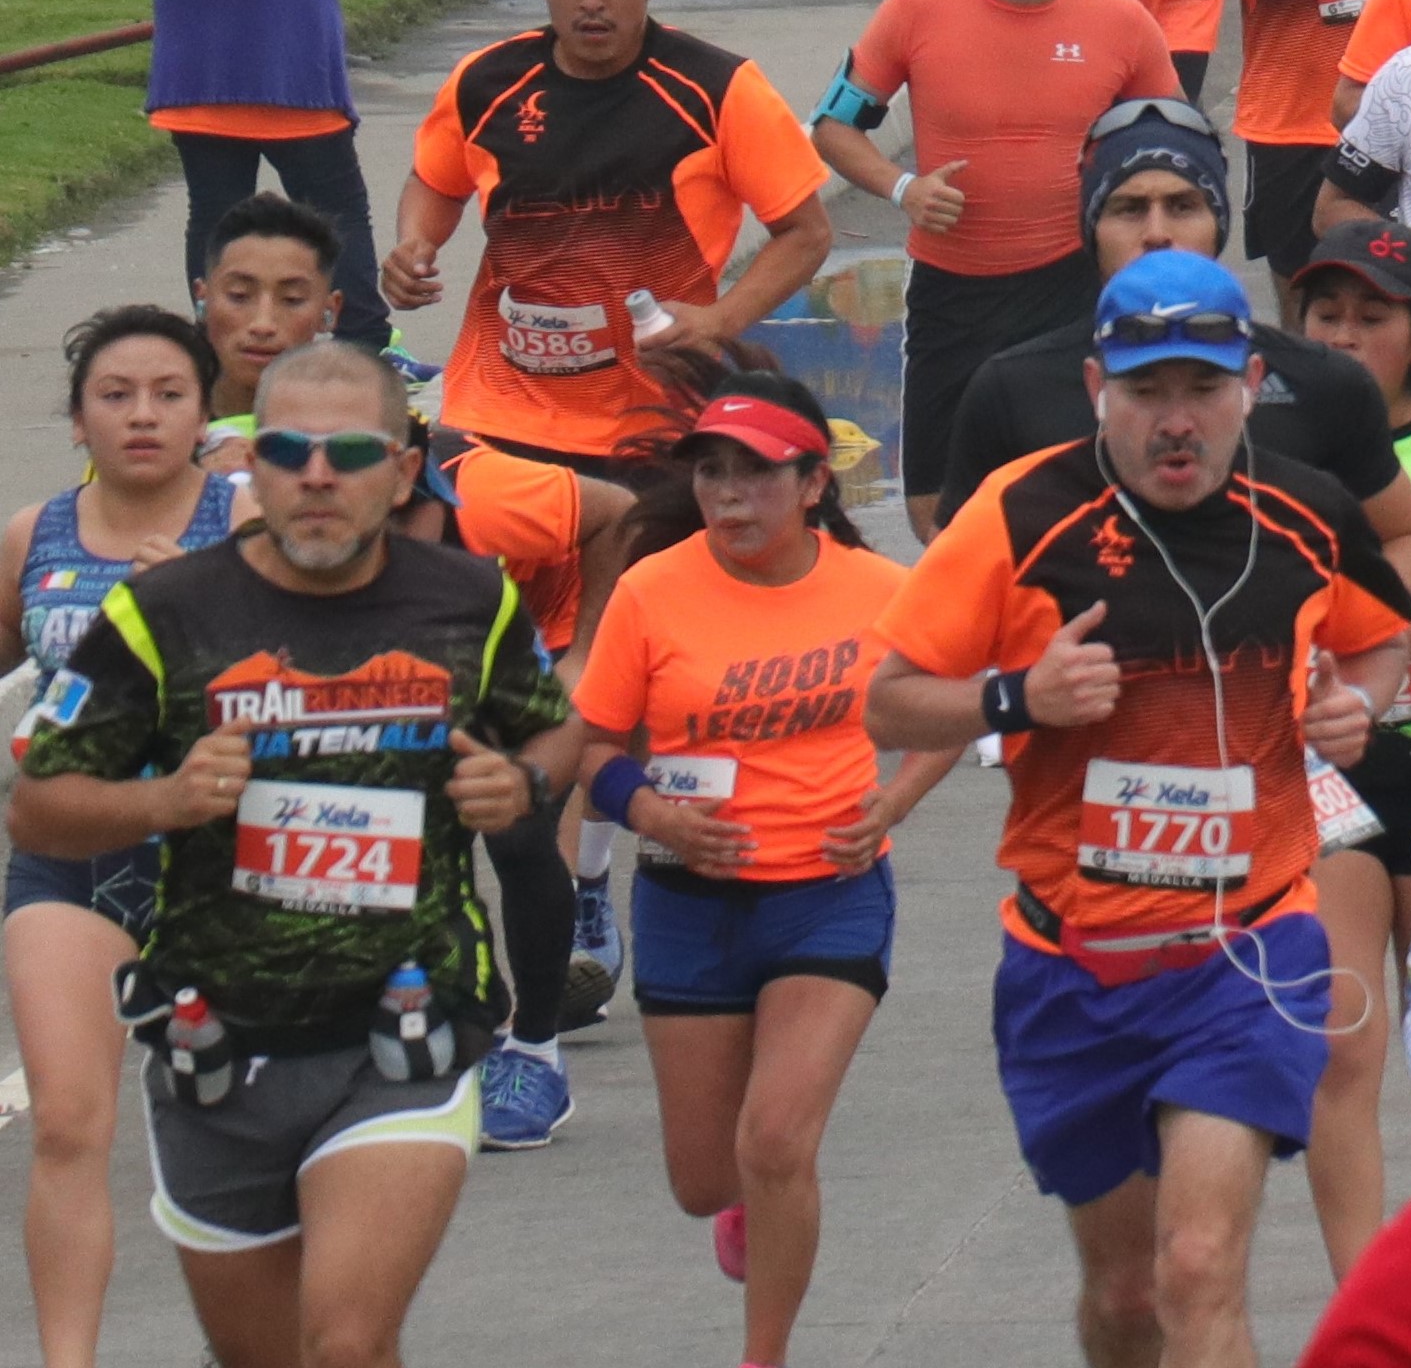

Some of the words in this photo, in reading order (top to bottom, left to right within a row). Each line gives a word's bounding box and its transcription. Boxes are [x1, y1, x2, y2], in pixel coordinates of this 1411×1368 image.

[530, 313, 569, 330] Xela
[507, 327, 594, 356] 0586
[713, 638, 859, 706] HOOP
[214, 680, 305, 724] TRAIL
[306, 682, 447, 714] RUNNERS
[685, 687, 856, 745] LEGEND
[667, 769, 699, 793] Xela
[1156, 782, 1210, 806] Xela
[311, 801, 371, 831] Xela
[1109, 809, 1233, 855] 1770
[265, 832, 394, 882] 1724
[1126, 872, 1202, 888] MEDALLA
